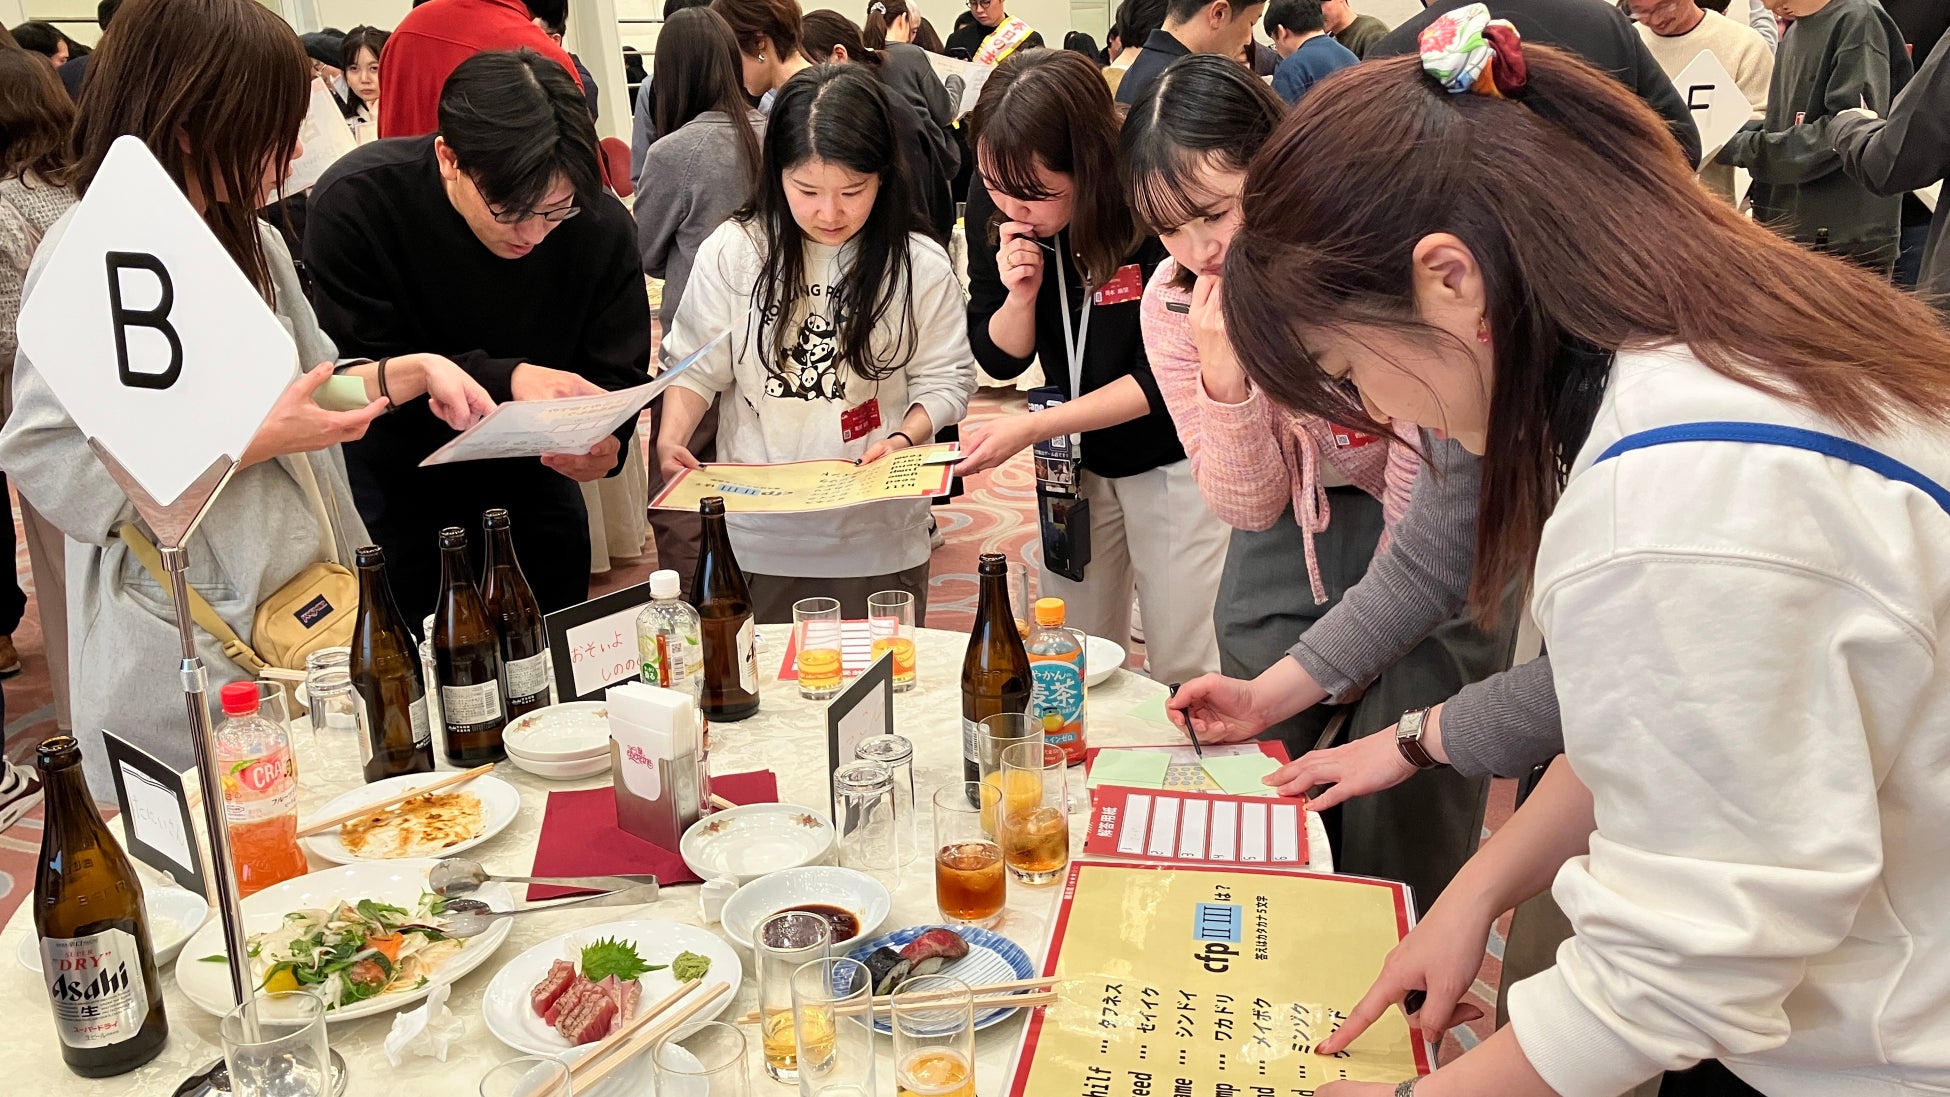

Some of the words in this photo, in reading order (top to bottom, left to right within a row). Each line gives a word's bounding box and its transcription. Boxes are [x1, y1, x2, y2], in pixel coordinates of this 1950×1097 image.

[1687, 84, 1715, 109] F
[105, 250, 184, 390] B
[571, 630, 623, 664] おそいよ
[601, 657, 641, 681] しのの
[1033, 678, 1077, 707] 麦茶
[253, 758, 287, 788] CRA
[1097, 806, 1118, 838] 解答用紙
[1255, 896, 1268, 960] 答えはカタカナ5文字
[65, 949, 94, 958] SUPER
[52, 960, 129, 1002] Asahi
[81, 1005, 101, 1018] 生
[1098, 984, 1123, 1028] タフネス
[1175, 989, 1198, 1037] シンドイ
[1213, 994, 1234, 1041] ワカドリ
[73, 1021, 118, 1033] スーパードライ
[1253, 997, 1272, 1048] メイボク
[1289, 1003, 1310, 1054] ミンゾク
[1127, 1071, 1152, 1097] eed
[1173, 1078, 1193, 1097] ame
[1215, 1083, 1241, 1097] mp
